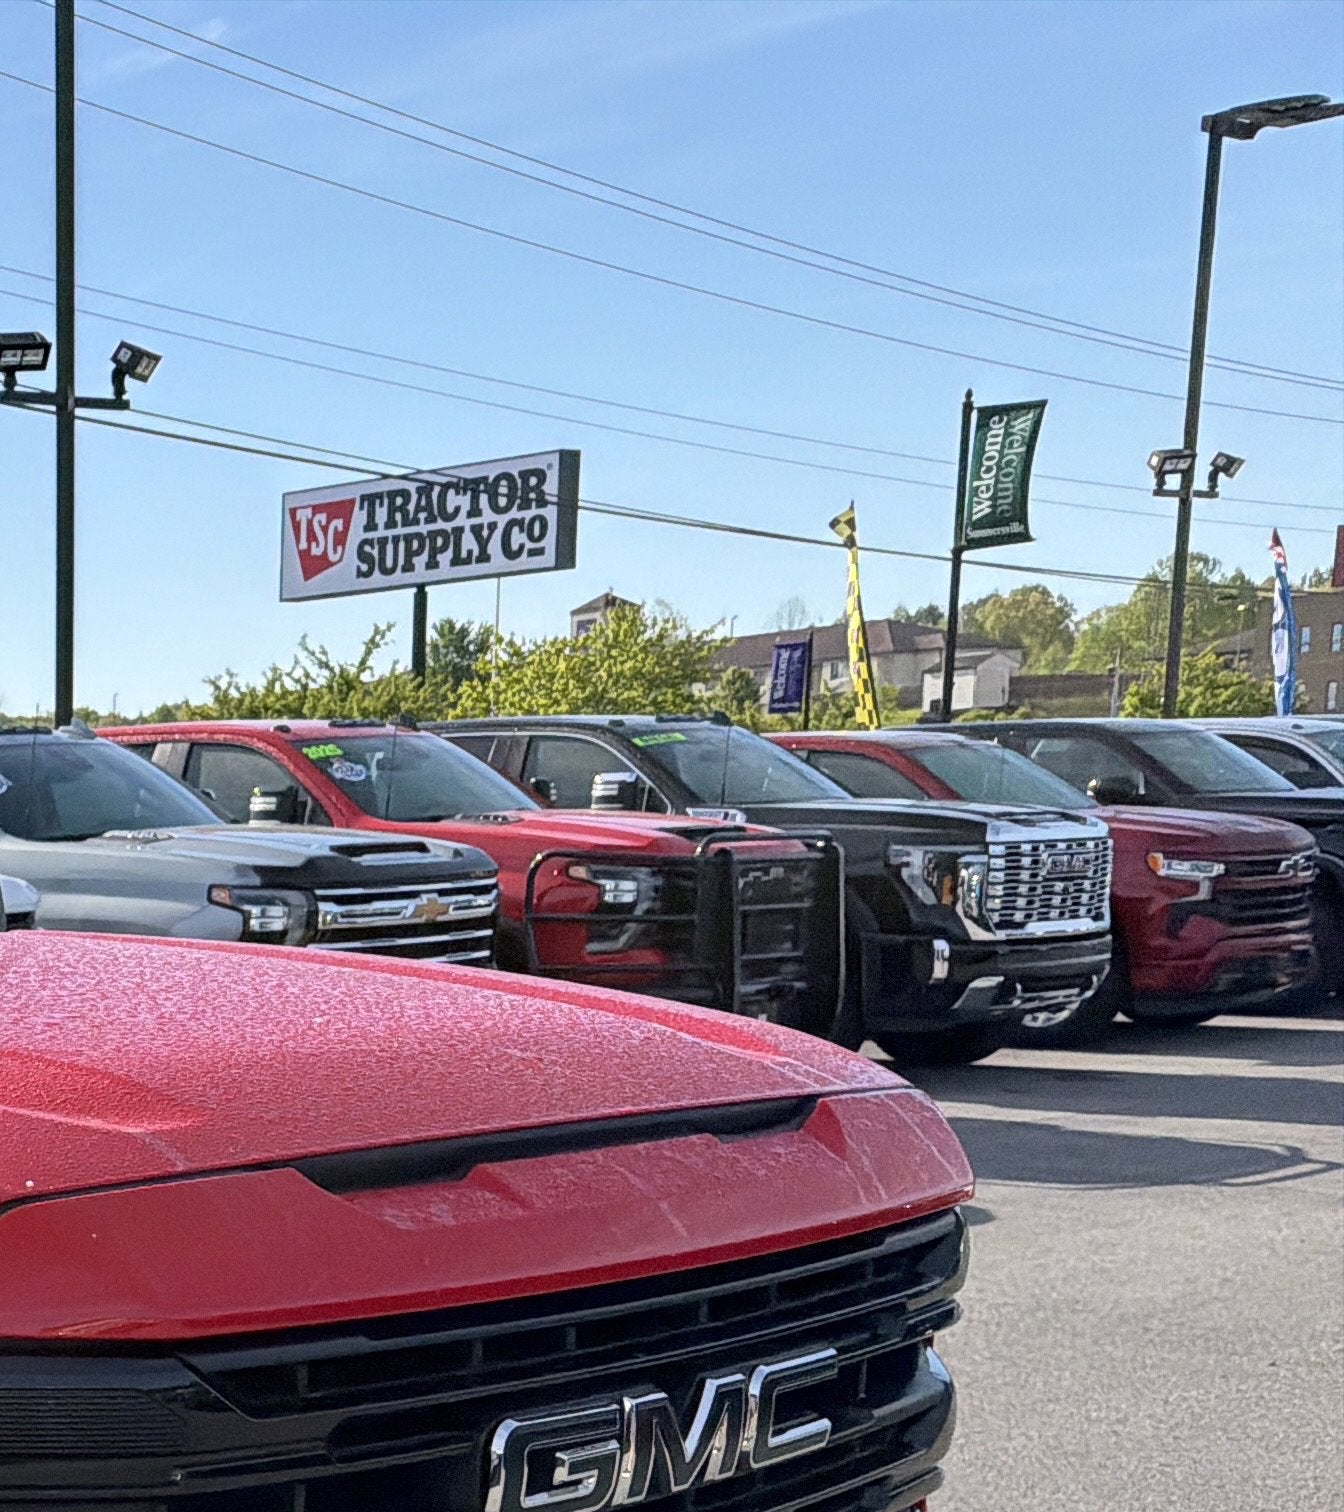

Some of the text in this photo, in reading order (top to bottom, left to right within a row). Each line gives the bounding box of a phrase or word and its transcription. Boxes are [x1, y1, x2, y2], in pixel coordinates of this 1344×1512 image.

[972, 415, 1008, 521] Welcome
[996, 408, 1036, 517] Welcome
[358, 467, 547, 532] TRACTOR
[296, 507, 343, 562] TSC
[355, 521, 499, 579] SUPPLY
